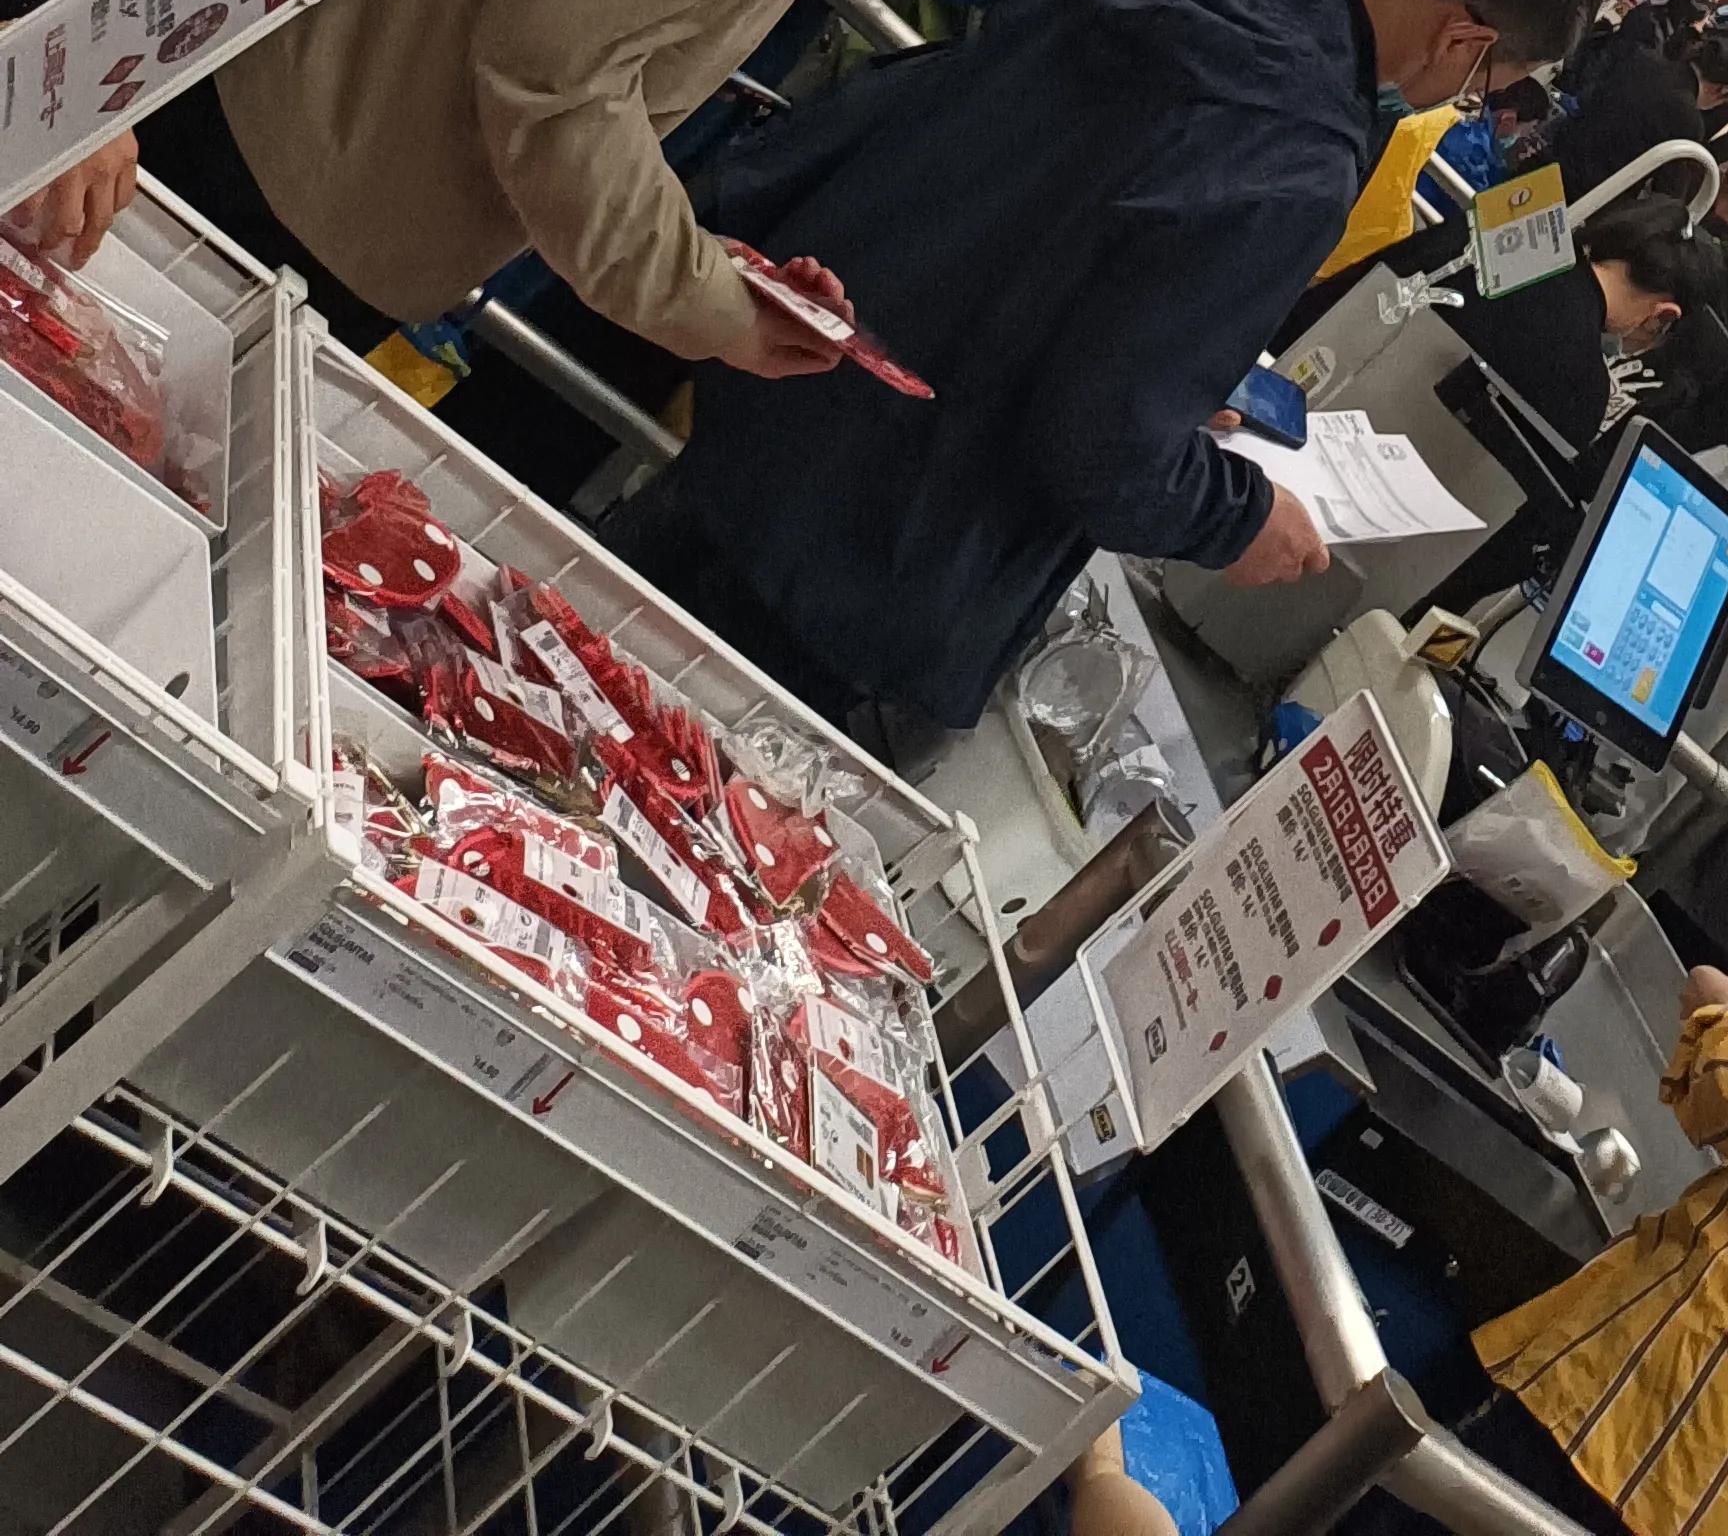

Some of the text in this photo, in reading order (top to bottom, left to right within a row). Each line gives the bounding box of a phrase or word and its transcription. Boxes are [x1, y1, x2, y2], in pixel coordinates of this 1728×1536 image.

[1304, 751, 1395, 914] 2月1日-2月28日
[1344, 731, 1418, 864] 限时特惠
